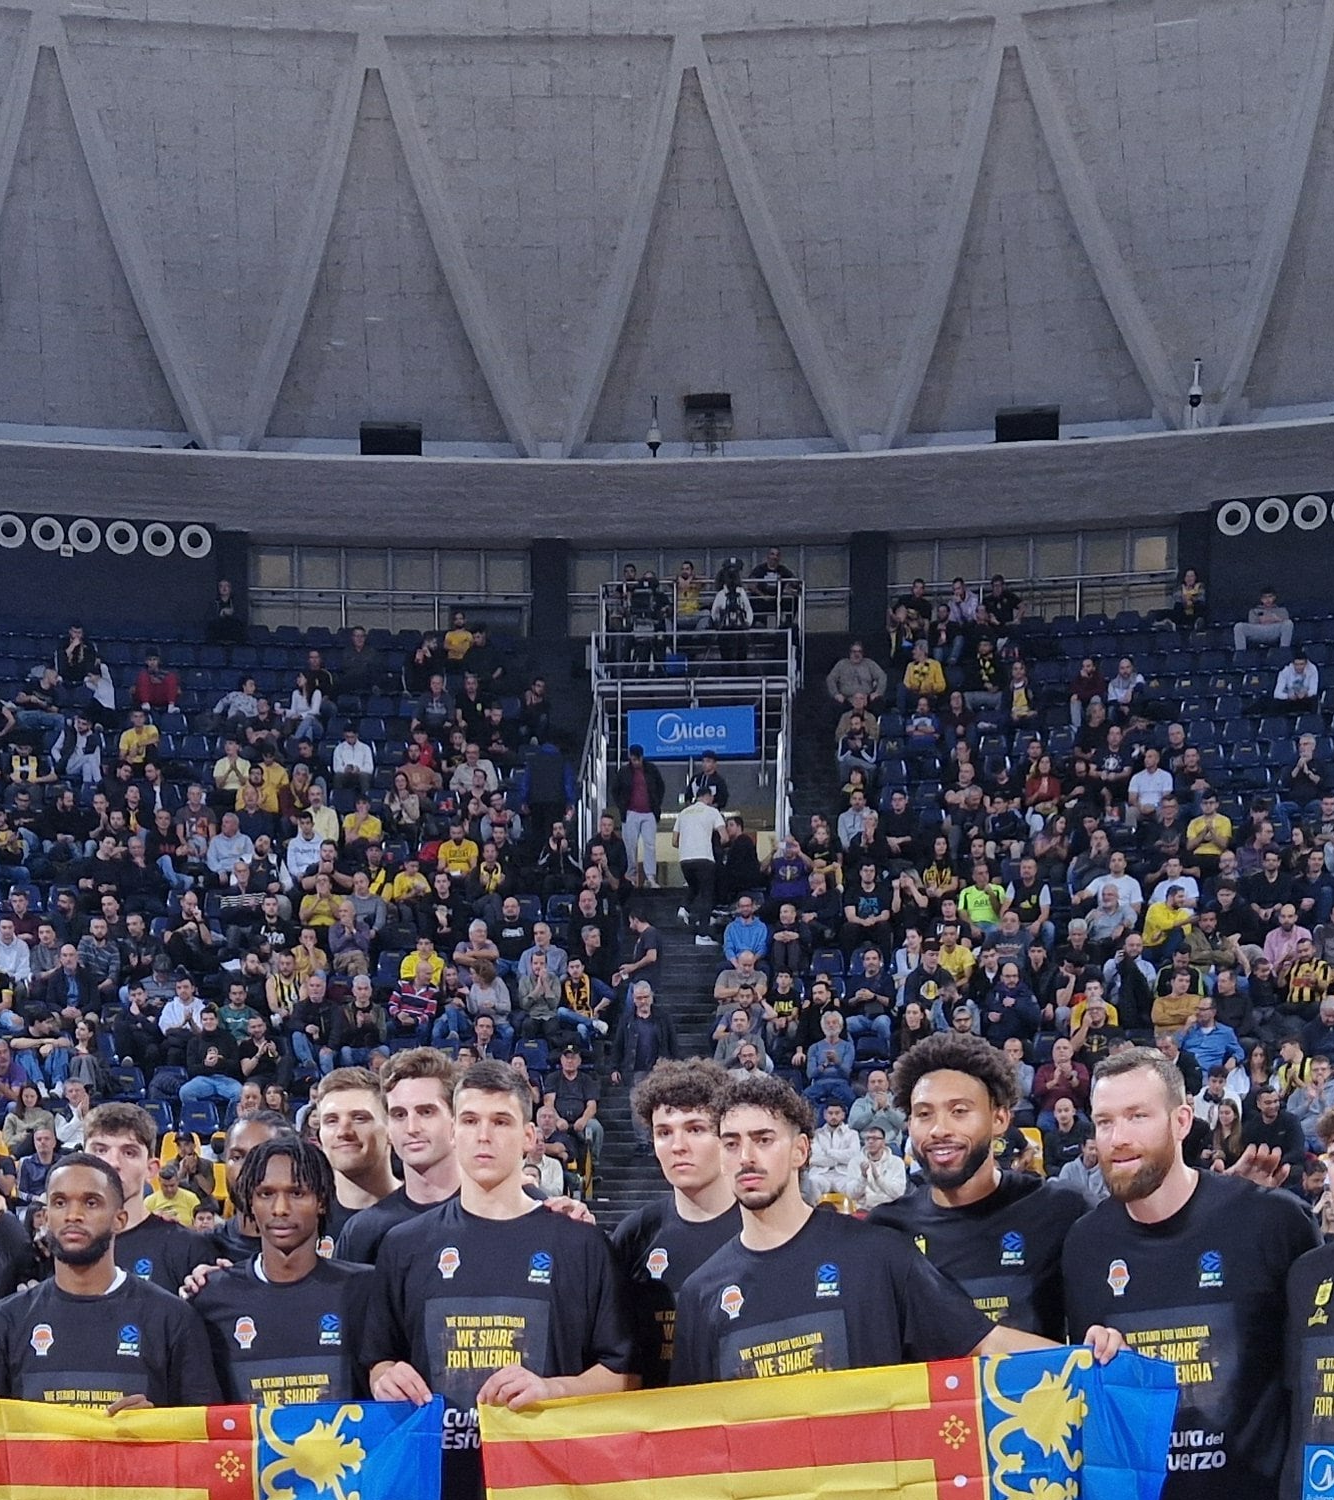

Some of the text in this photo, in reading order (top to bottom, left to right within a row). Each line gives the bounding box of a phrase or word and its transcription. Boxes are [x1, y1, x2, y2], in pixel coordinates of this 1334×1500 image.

[667, 719, 726, 740] Midea
[457, 1330, 516, 1348] WE SHARE
[447, 1351, 521, 1369] FOR VALENCIA
[1160, 1341, 1200, 1362] SHARE
[754, 1349, 816, 1378] WE SHARE
[44, 1391, 55, 1401] WE
[55, 1390, 75, 1401] STAND
[77, 1390, 89, 1401] FOR
[1314, 1397, 1333, 1417] FOR
[1205, 1431, 1225, 1446] del
